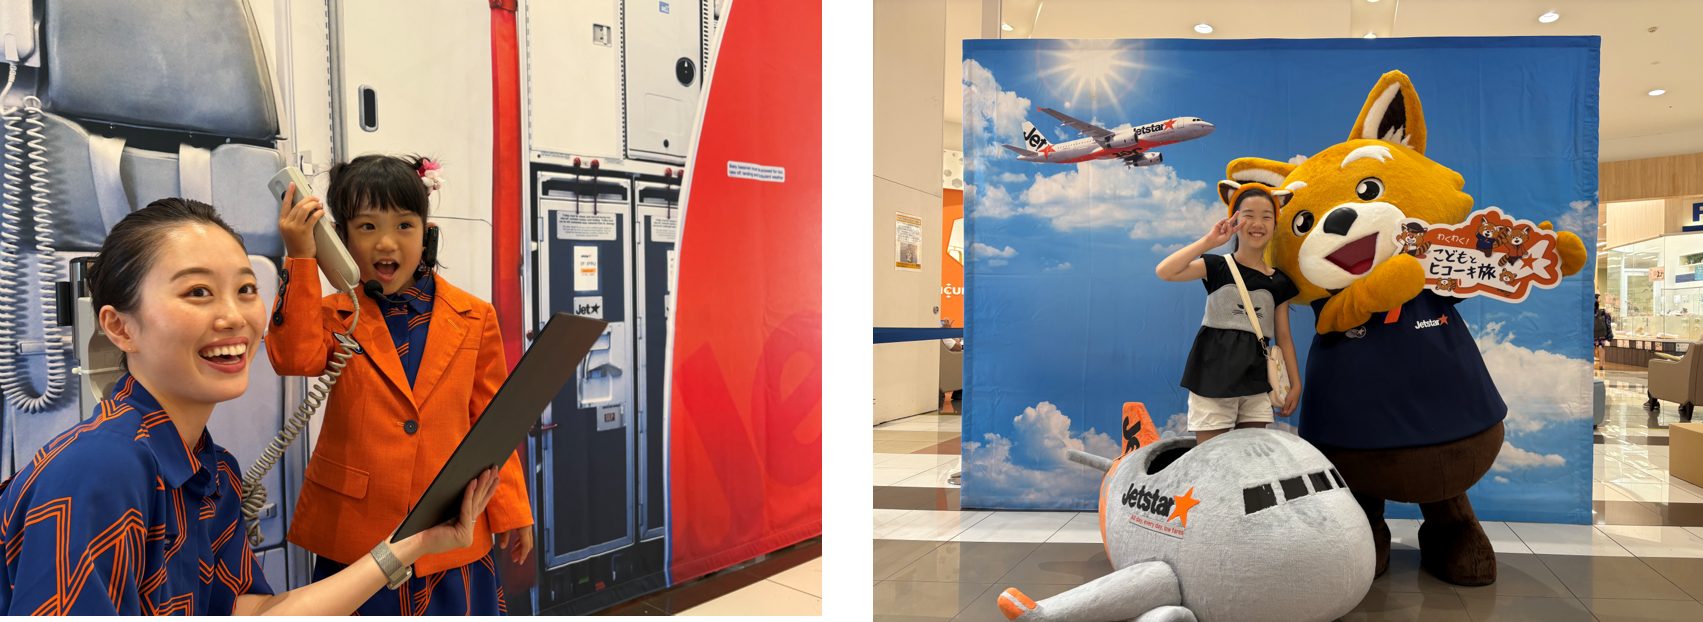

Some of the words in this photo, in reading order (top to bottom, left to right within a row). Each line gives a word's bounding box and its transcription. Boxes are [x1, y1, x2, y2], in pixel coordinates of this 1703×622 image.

[1023, 127, 1047, 151] Jet
[1437, 233, 1470, 245] わくわく!
[1433, 249, 1477, 264] こどもと
[1430, 262, 1496, 280] ヒコーキ旅
[576, 304, 591, 315] Jet
[1415, 319, 1440, 329] Jetstar
[1121, 416, 1141, 456] Je
[1122, 483, 1175, 517] Jetstar
[1143, 519, 1155, 528] every
[1171, 527, 1184, 536] fares
